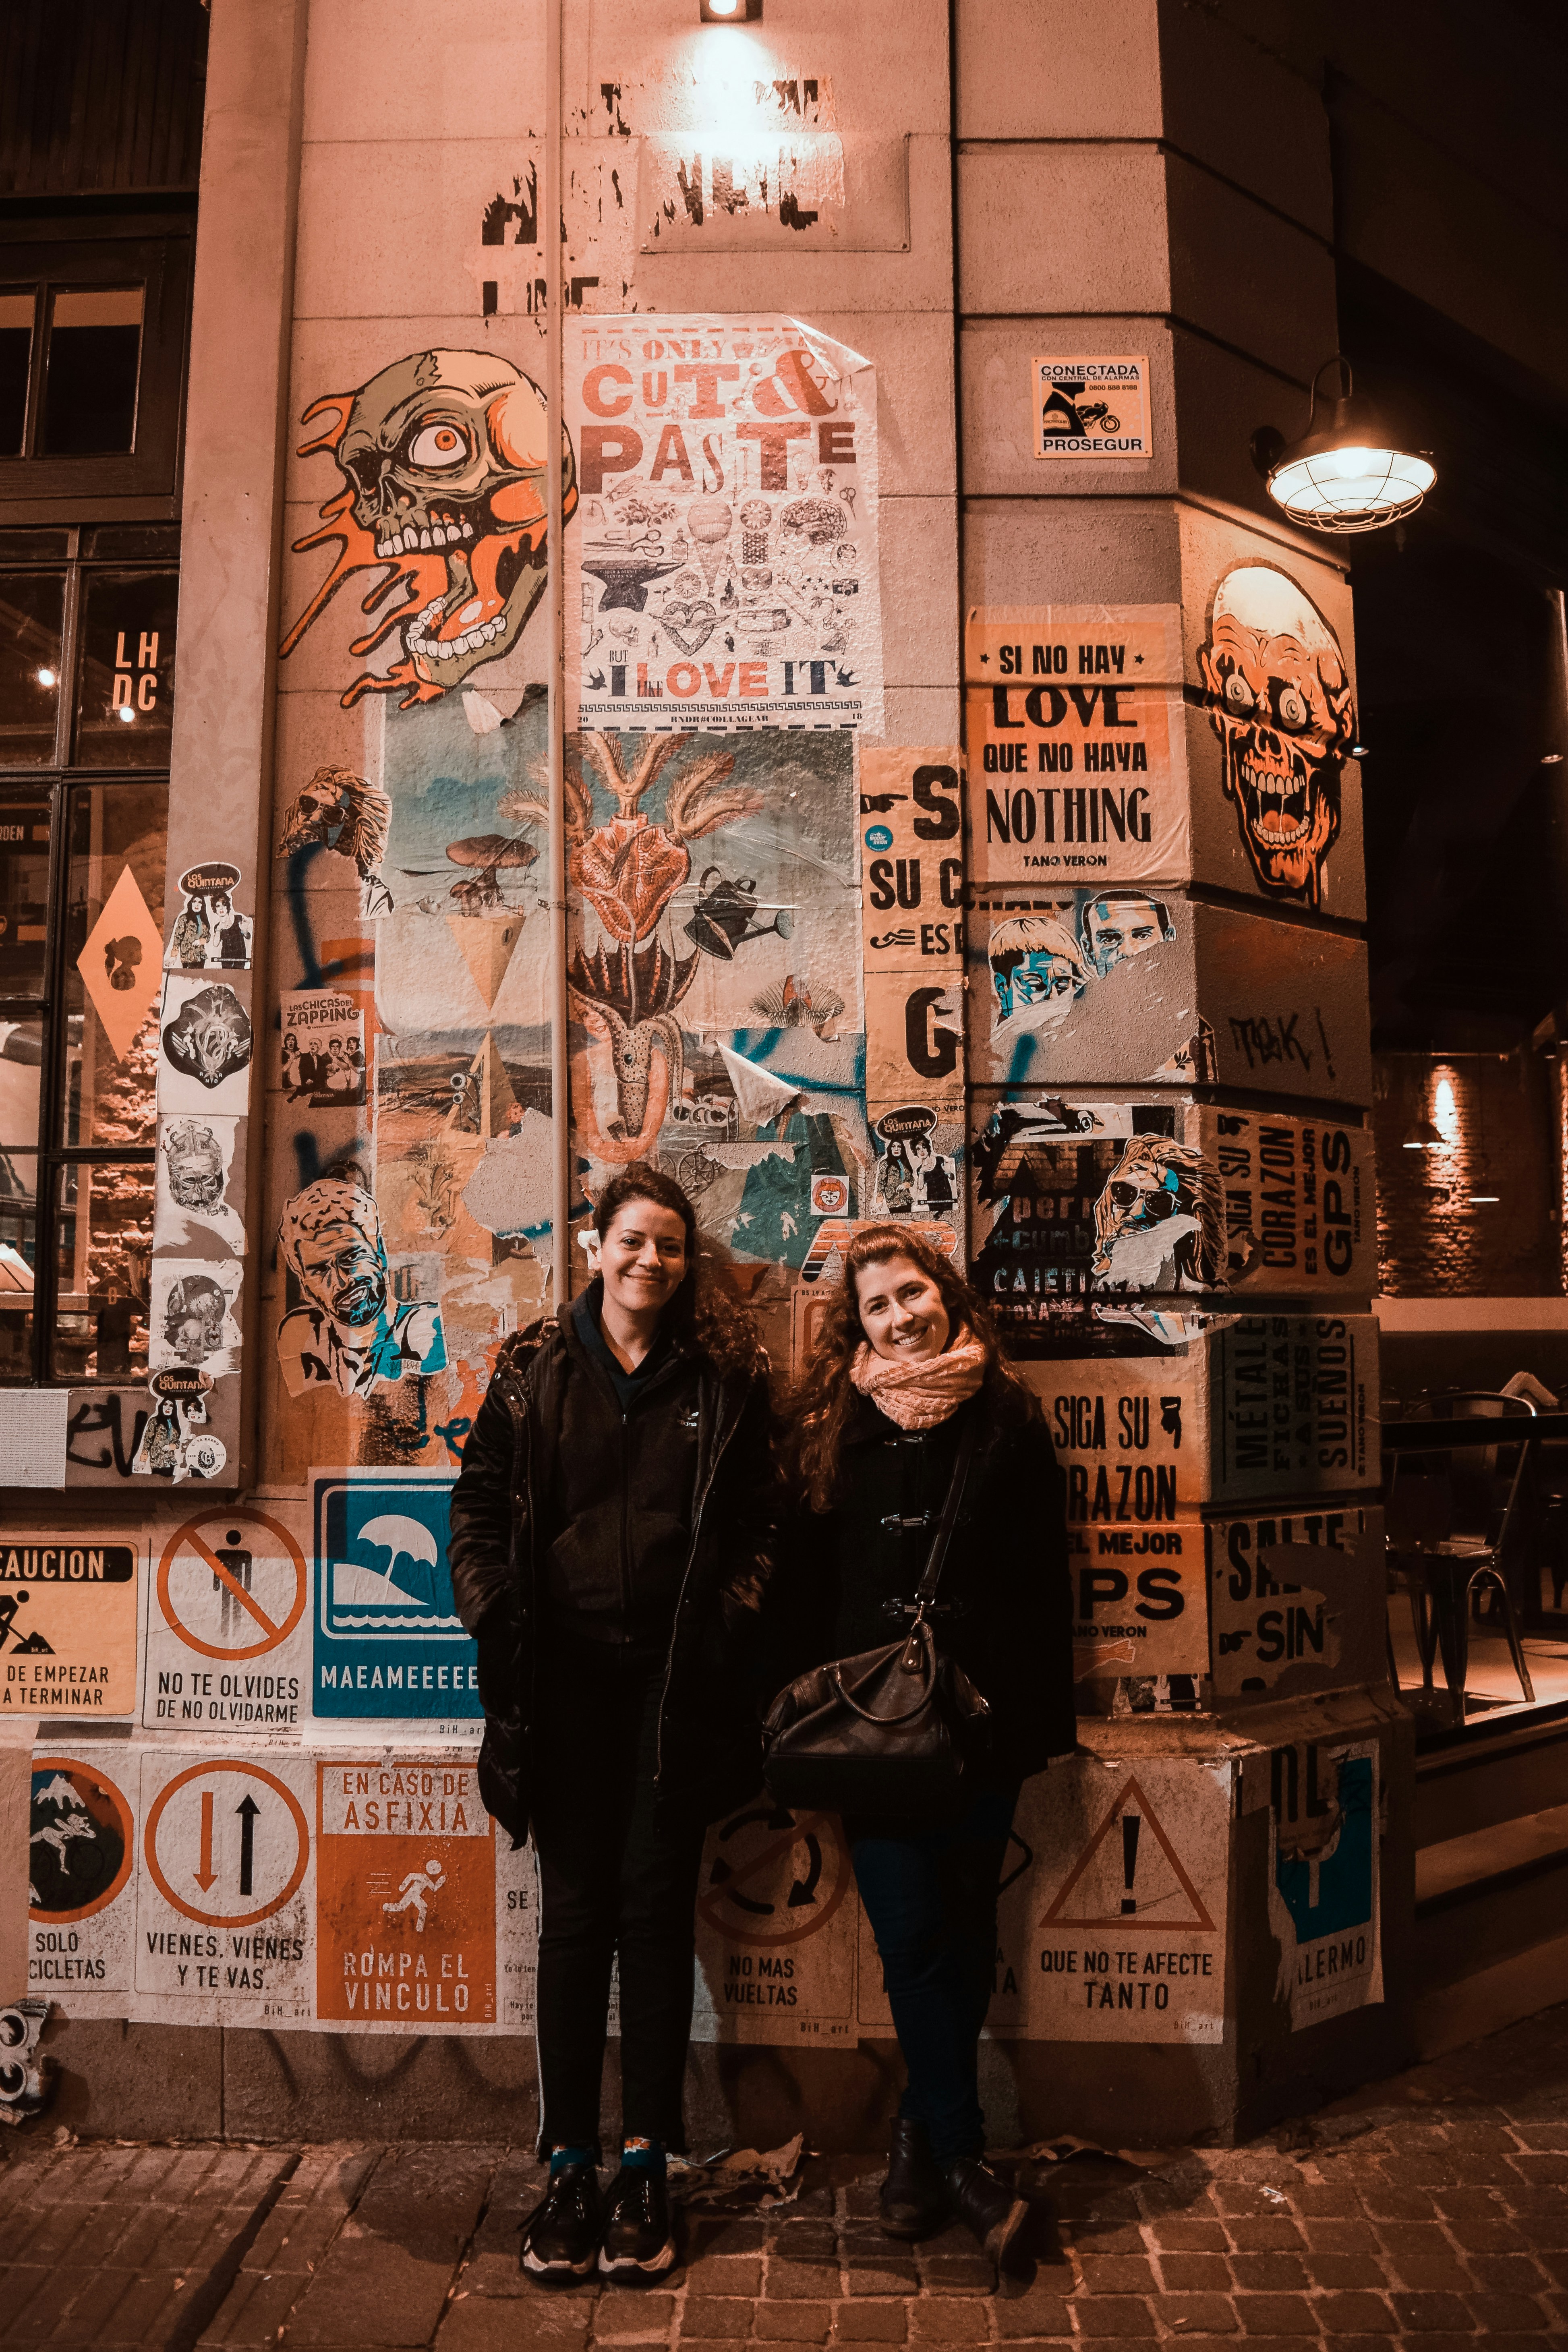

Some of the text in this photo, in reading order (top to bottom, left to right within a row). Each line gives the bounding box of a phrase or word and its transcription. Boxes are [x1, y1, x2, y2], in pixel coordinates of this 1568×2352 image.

[643, 339, 727, 360] ONLY
[1041, 365, 1139, 376] CONECTADA
[582, 364, 739, 419] CUT
[580, 422, 856, 494] PASTE
[1043, 439, 1142, 451] PROSEGUR
[609, 650, 628, 662] BUT
[999, 645, 1125, 674] SI NO HAY
[637, 662, 768, 698] LOVE
[780, 660, 836, 695] IT
[992, 685, 1138, 728] LOVE
[983, 742, 1148, 773] QUE NO HAYA
[986, 787, 1151, 844] NOTHING
[1023, 855, 1107, 867] TANO VERON
[188, 877, 235, 888] QUINTANA
[869, 858, 921, 911] SU
[287, 1008, 359, 1027] ZAPPING
[884, 1119, 932, 1133] QUINTANA
[1218, 1145, 1251, 1178] SU
[1259, 1126, 1297, 1268] CORAZON
[1302, 1128, 1318, 1275] ES EL MEJOR
[1322, 1130, 1353, 1277] GPS
[1272, 1317, 1290, 1472] FICHAS
[1312, 1319, 1348, 1469] SUEÑOS
[1054, 1395, 1149, 1450] SIGA SU
[1295, 1422, 1312, 1447] A
[1098, 1532, 1183, 1555] MEJOR
[0, 1549, 104, 1579] AUCION
[1079, 1567, 1185, 1621] PS
[1072, 1625, 1147, 1638] ANO VERON
[1256, 1604, 1324, 1663] SIN
[8, 1665, 109, 1683] DE EMPEZAR
[159, 1672, 299, 1700] NO TE OLVIDES
[3, 1687, 104, 1706] A TERMINAR
[157, 1698, 298, 1724] DE NO OLVIDARME
[343, 1772, 469, 1796] EN CASO DE
[344, 1801, 468, 1832] ASFIXIA
[35, 1932, 79, 1953] SOLO
[147, 1932, 304, 1961] VIENES, VIENES
[178, 1964, 188, 1986] Y
[199, 1965, 219, 1988] TE
[344, 1951, 469, 1978] ROMPA EL
[730, 1956, 794, 1978] NO MAS
[1041, 1949, 1212, 1975] QUE NO TE AFECTE
[344, 1981, 469, 2012] VINCULO
[725, 1982, 797, 2006] VUELTAS
[1084, 1981, 1169, 2010] TANTO
